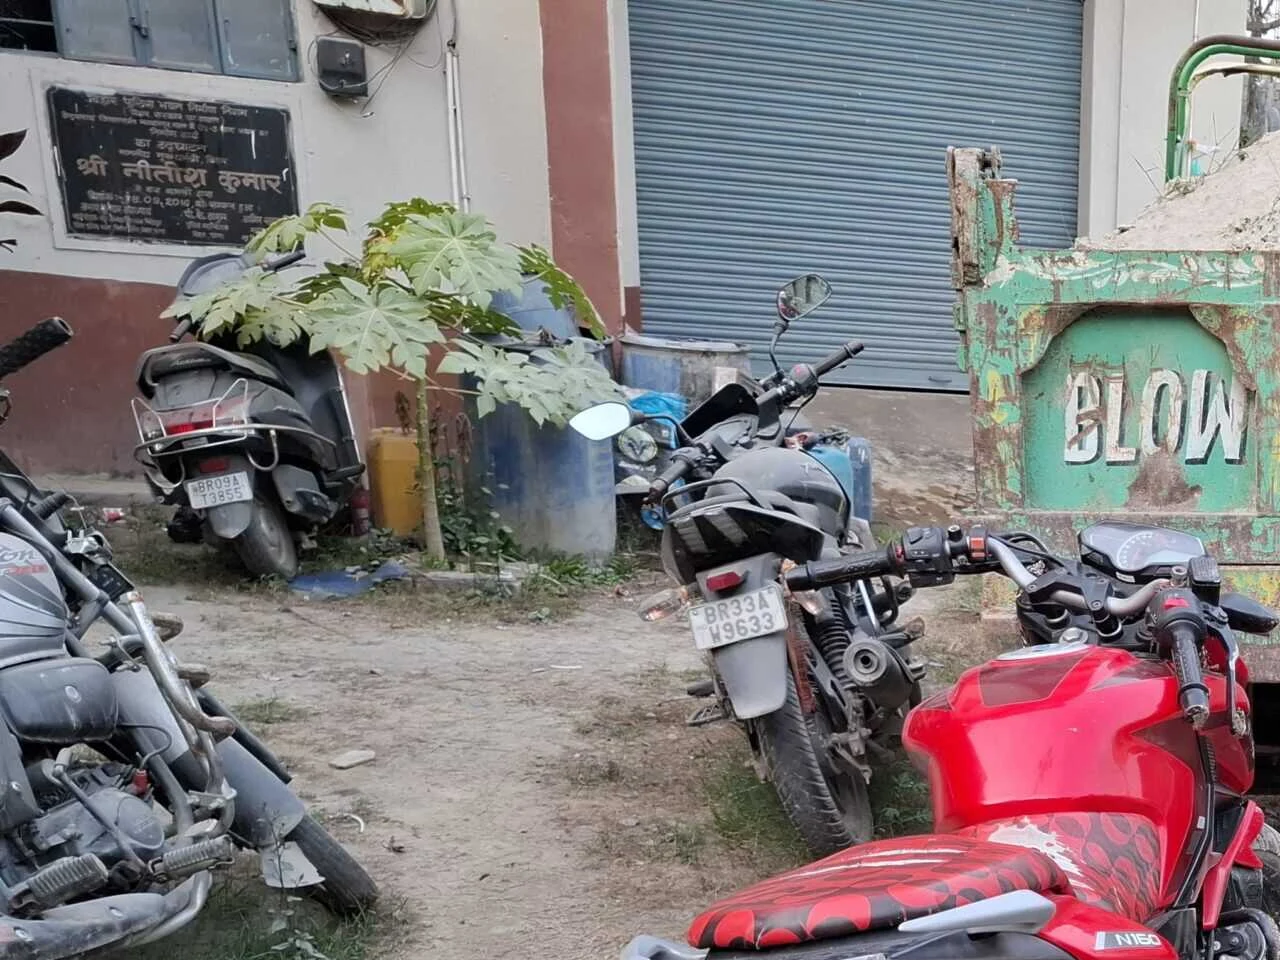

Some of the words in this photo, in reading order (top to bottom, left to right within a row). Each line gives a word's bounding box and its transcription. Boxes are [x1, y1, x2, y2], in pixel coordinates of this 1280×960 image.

[76, 153, 110, 176] श्री
[120, 159, 208, 187] नीतीश
[218, 170, 283, 195] कुमार
[1064, 370, 1252, 465] BLOW
[704, 592, 770, 625] BR33A
[709, 612, 775, 643] W9633
[1115, 933, 1162, 946] N160
